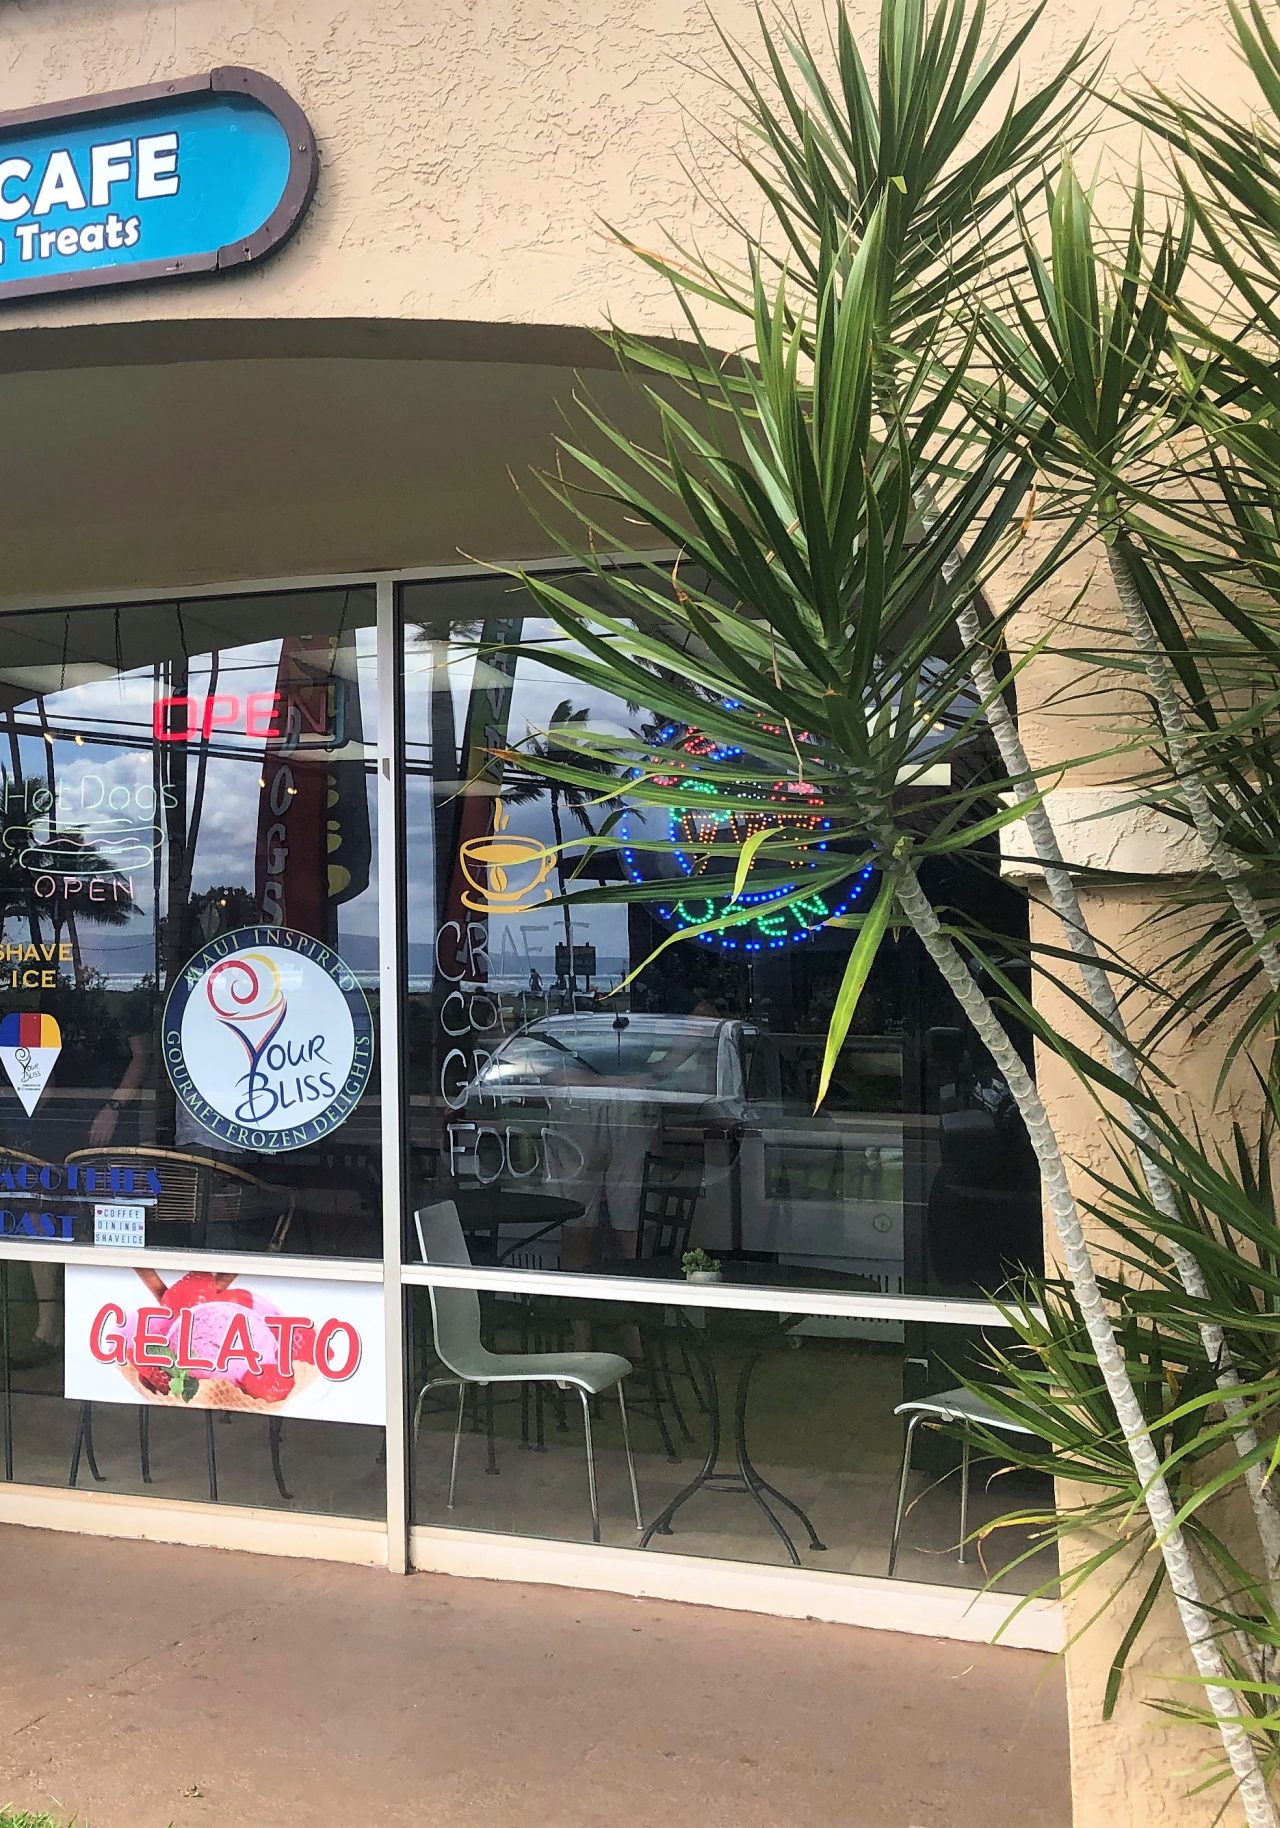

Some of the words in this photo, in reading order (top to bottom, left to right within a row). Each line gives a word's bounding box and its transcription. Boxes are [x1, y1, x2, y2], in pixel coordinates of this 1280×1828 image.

[14, 213, 141, 262] Treats
[153, 691, 328, 742] OPEN
[34, 875, 135, 902] OPEN
[184, 935, 241, 985] MAUI
[254, 928, 356, 993] INSPIRED
[435, 919, 590, 982] CRAFT
[11, 970, 57, 988] ICE
[166, 1030, 224, 1129] GOURMET
[226, 1125, 308, 1149] FROZEN
[312, 1036, 371, 1135] DELIGHTS
[234, 1070, 337, 1126] BLISS
[103, 1208, 140, 1219] COFFEE
[89, 1302, 362, 1381] GELATO
